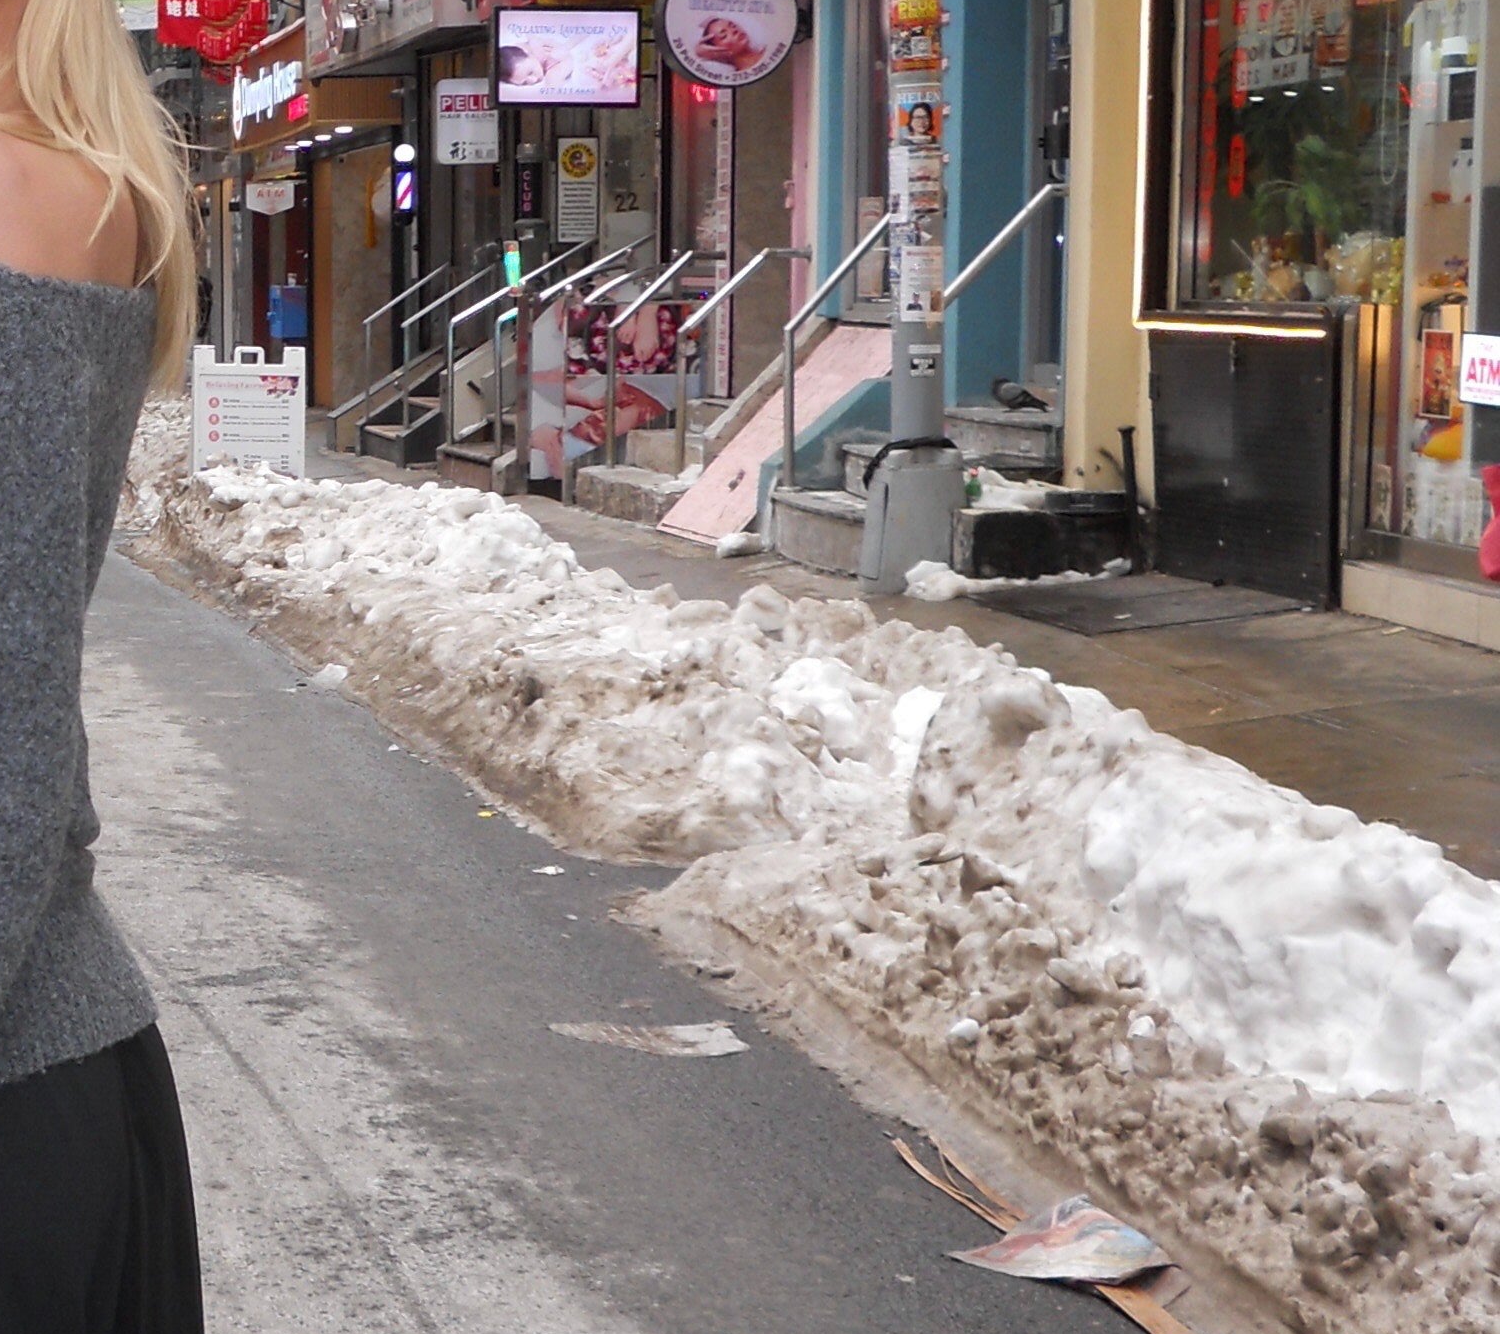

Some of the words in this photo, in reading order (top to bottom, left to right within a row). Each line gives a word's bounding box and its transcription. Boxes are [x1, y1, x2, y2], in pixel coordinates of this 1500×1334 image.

[679, 49, 695, 66] Pell
[694, 64, 723, 81] Street
[441, 96, 489, 111] PELL
[614, 192, 640, 213] 22
[1465, 357, 1500, 385] ATM
